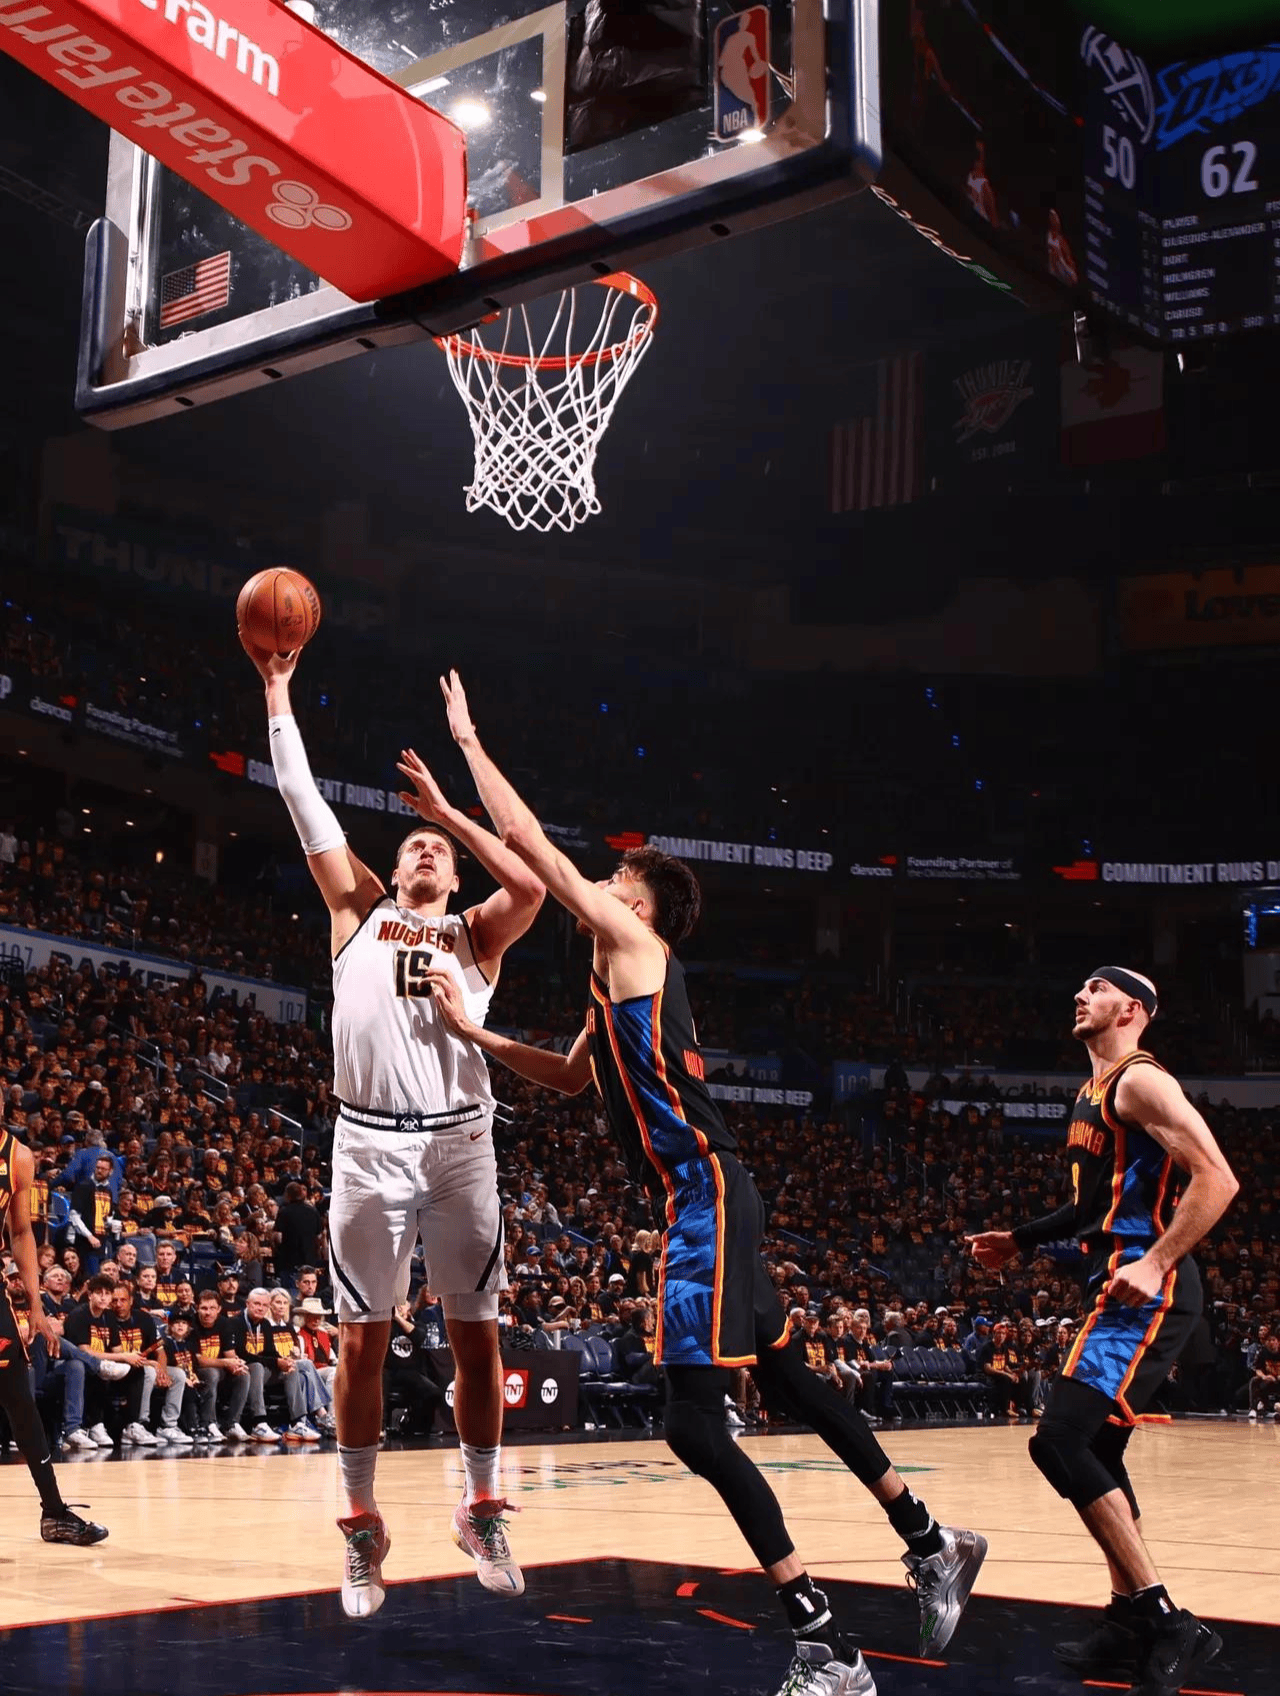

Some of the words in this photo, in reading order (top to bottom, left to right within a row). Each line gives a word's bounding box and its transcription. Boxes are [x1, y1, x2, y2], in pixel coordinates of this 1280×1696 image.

[723, 108, 748, 134] NBA
[1103, 124, 1136, 190] 50
[1201, 140, 1259, 198] 62
[952, 359, 1032, 400] THUNDER
[345, 783, 386, 811] RUNS
[649, 834, 753, 864] COMMITMENT
[753, 845, 795, 869] RUNS
[796, 849, 834, 872] DEEP
[906, 856, 958, 870] Founding
[1101, 862, 1214, 884] COMMITMENT
[1216, 862, 1265, 883] RUNS
[395, 950, 433, 998] 15
[279, 1000, 304, 1024] 107
[540, 1386, 559, 1398] TNT
